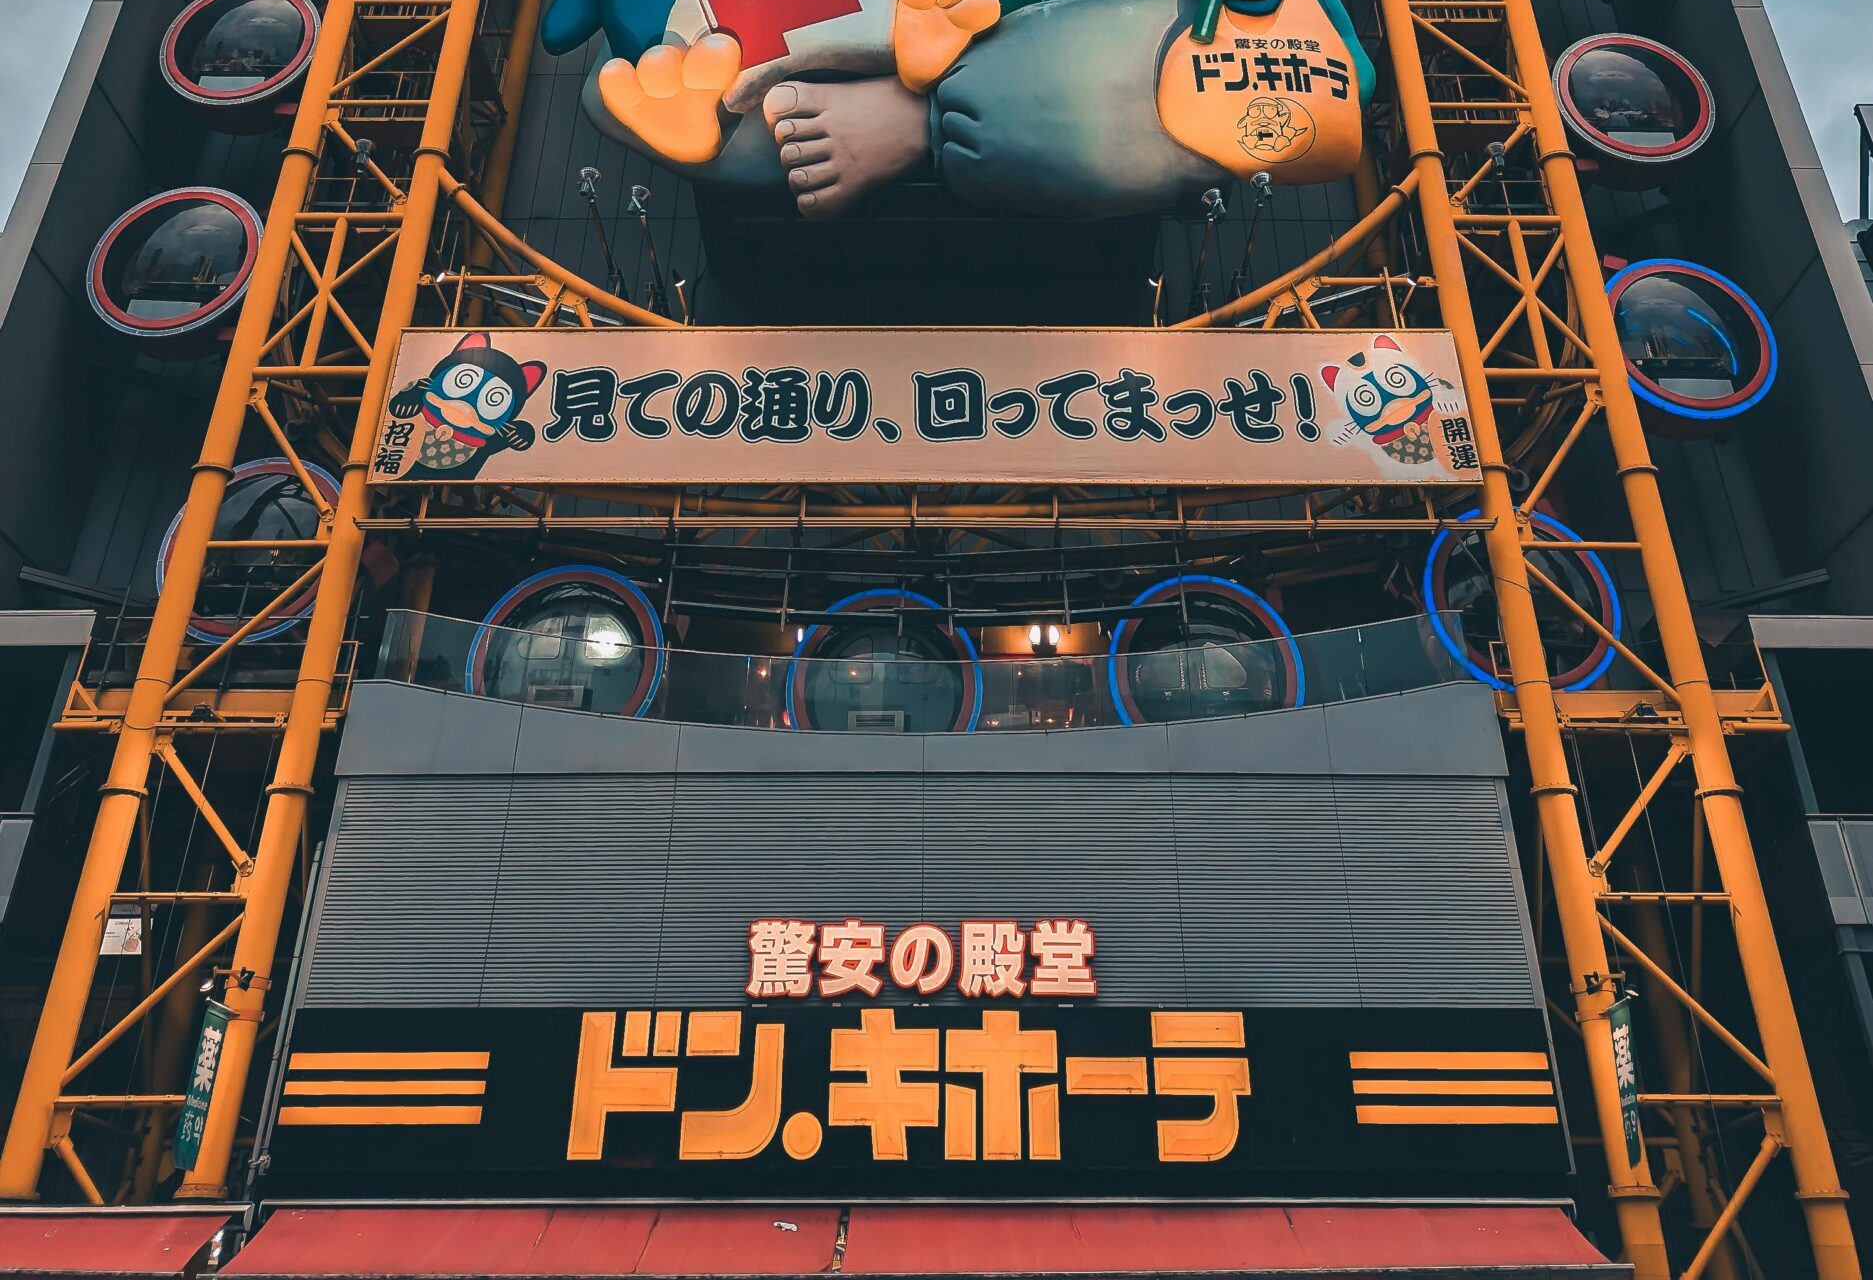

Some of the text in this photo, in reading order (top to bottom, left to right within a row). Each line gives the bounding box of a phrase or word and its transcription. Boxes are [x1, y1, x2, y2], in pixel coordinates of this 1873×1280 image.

[1234, 38, 1321, 53] 驚安の殿堂
[374, 420, 415, 474] 招福
[1440, 417, 1479, 470] 開運
[745, 919, 1098, 998] 驚安の殿堂
